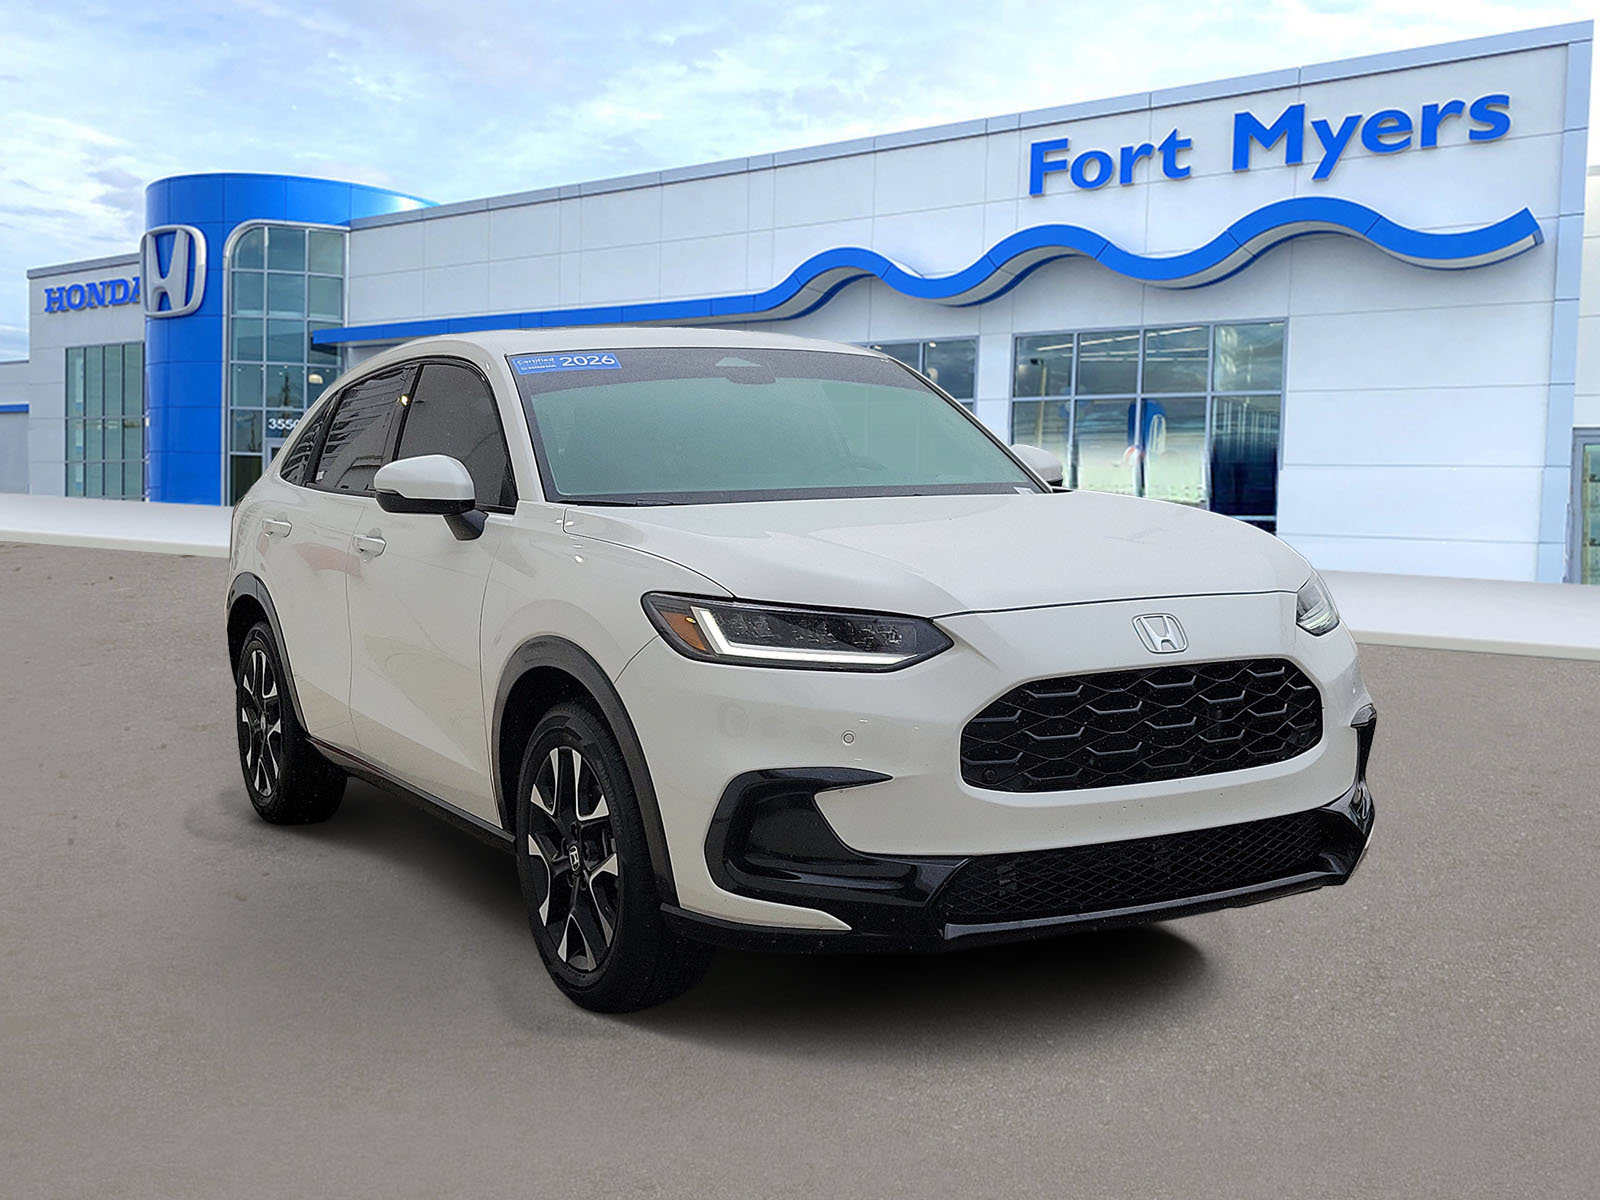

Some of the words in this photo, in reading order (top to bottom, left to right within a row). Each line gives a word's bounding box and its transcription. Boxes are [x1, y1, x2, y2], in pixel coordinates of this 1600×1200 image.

[1029, 128, 1192, 196] Fort
[1232, 93, 1511, 180] Myers
[559, 355, 616, 367] 2026
